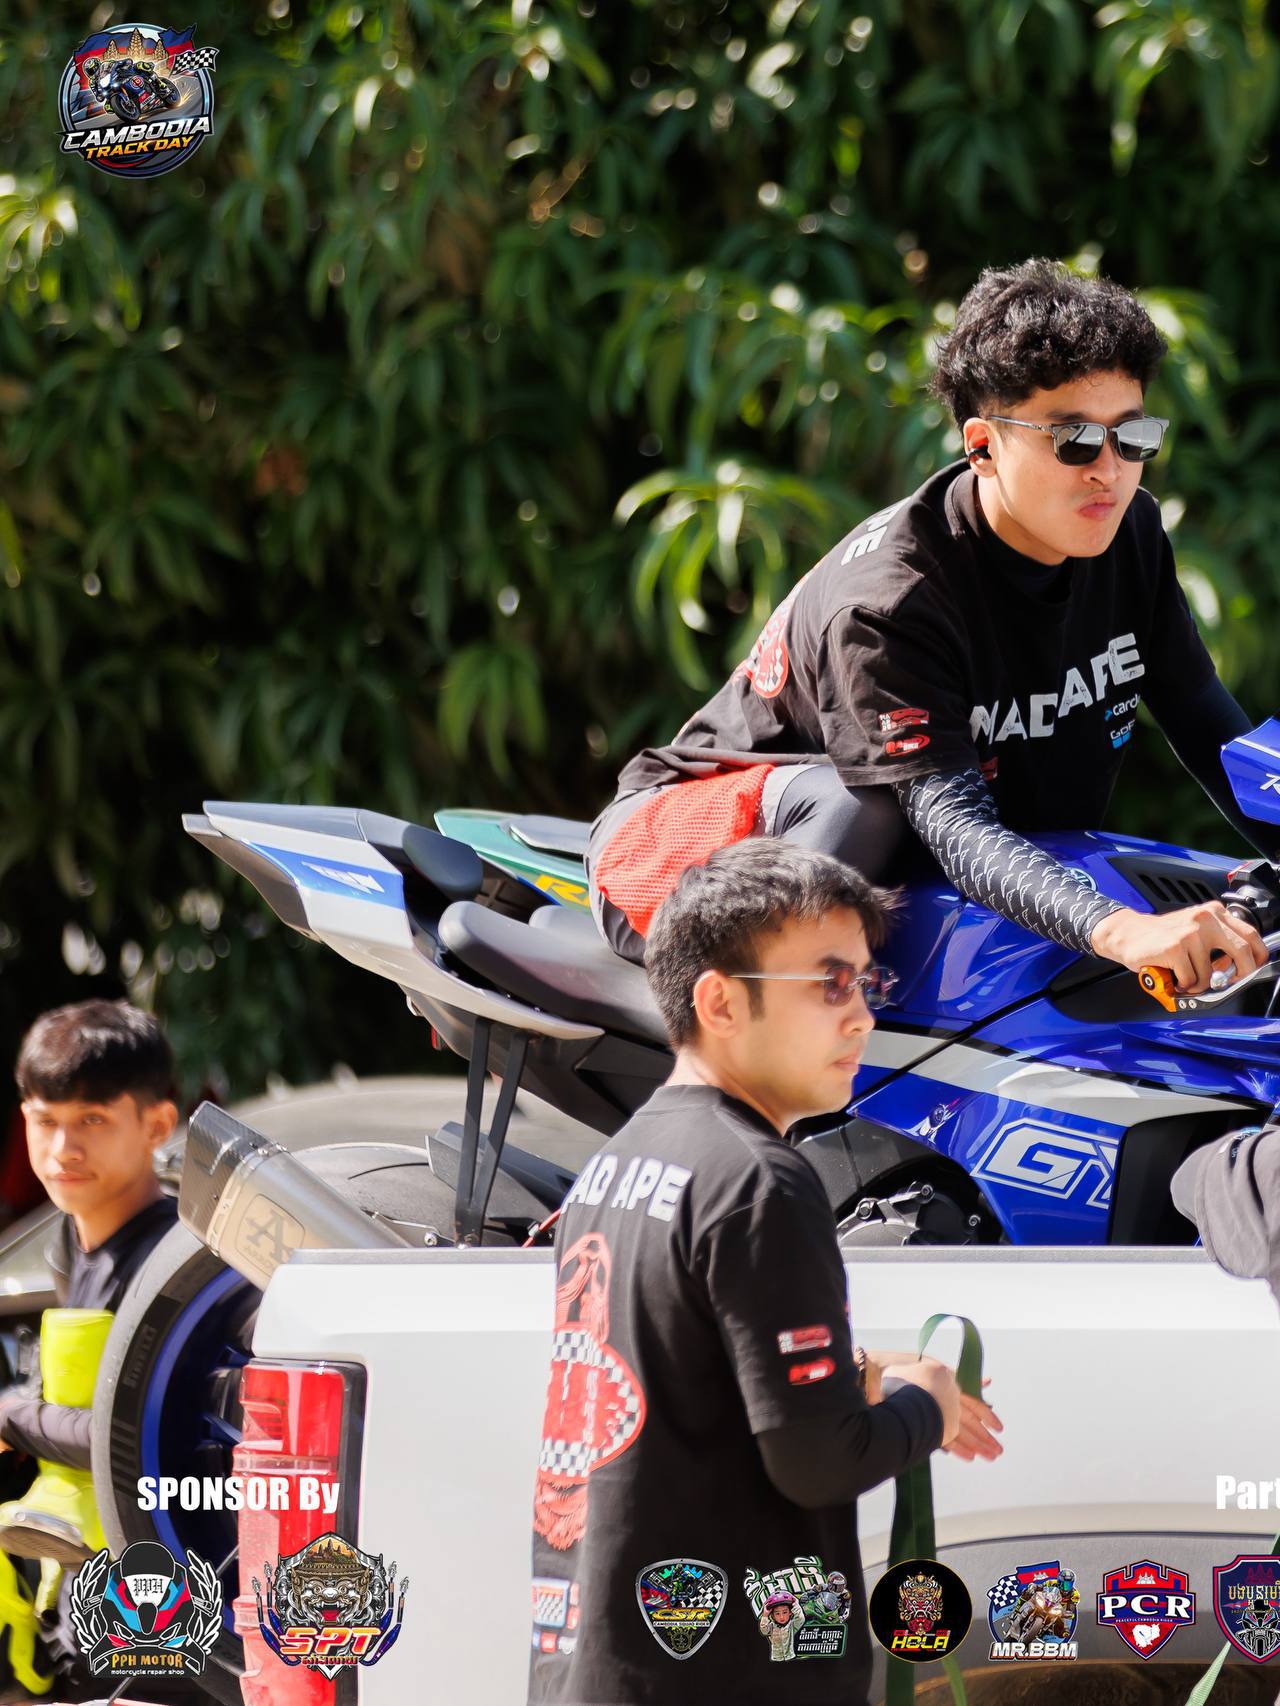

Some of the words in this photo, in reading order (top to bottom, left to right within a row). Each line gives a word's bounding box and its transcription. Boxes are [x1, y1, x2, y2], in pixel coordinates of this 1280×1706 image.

[1112, 693, 1141, 716] card
[560, 1154, 618, 1213] AD
[610, 1156, 693, 1222] APE
